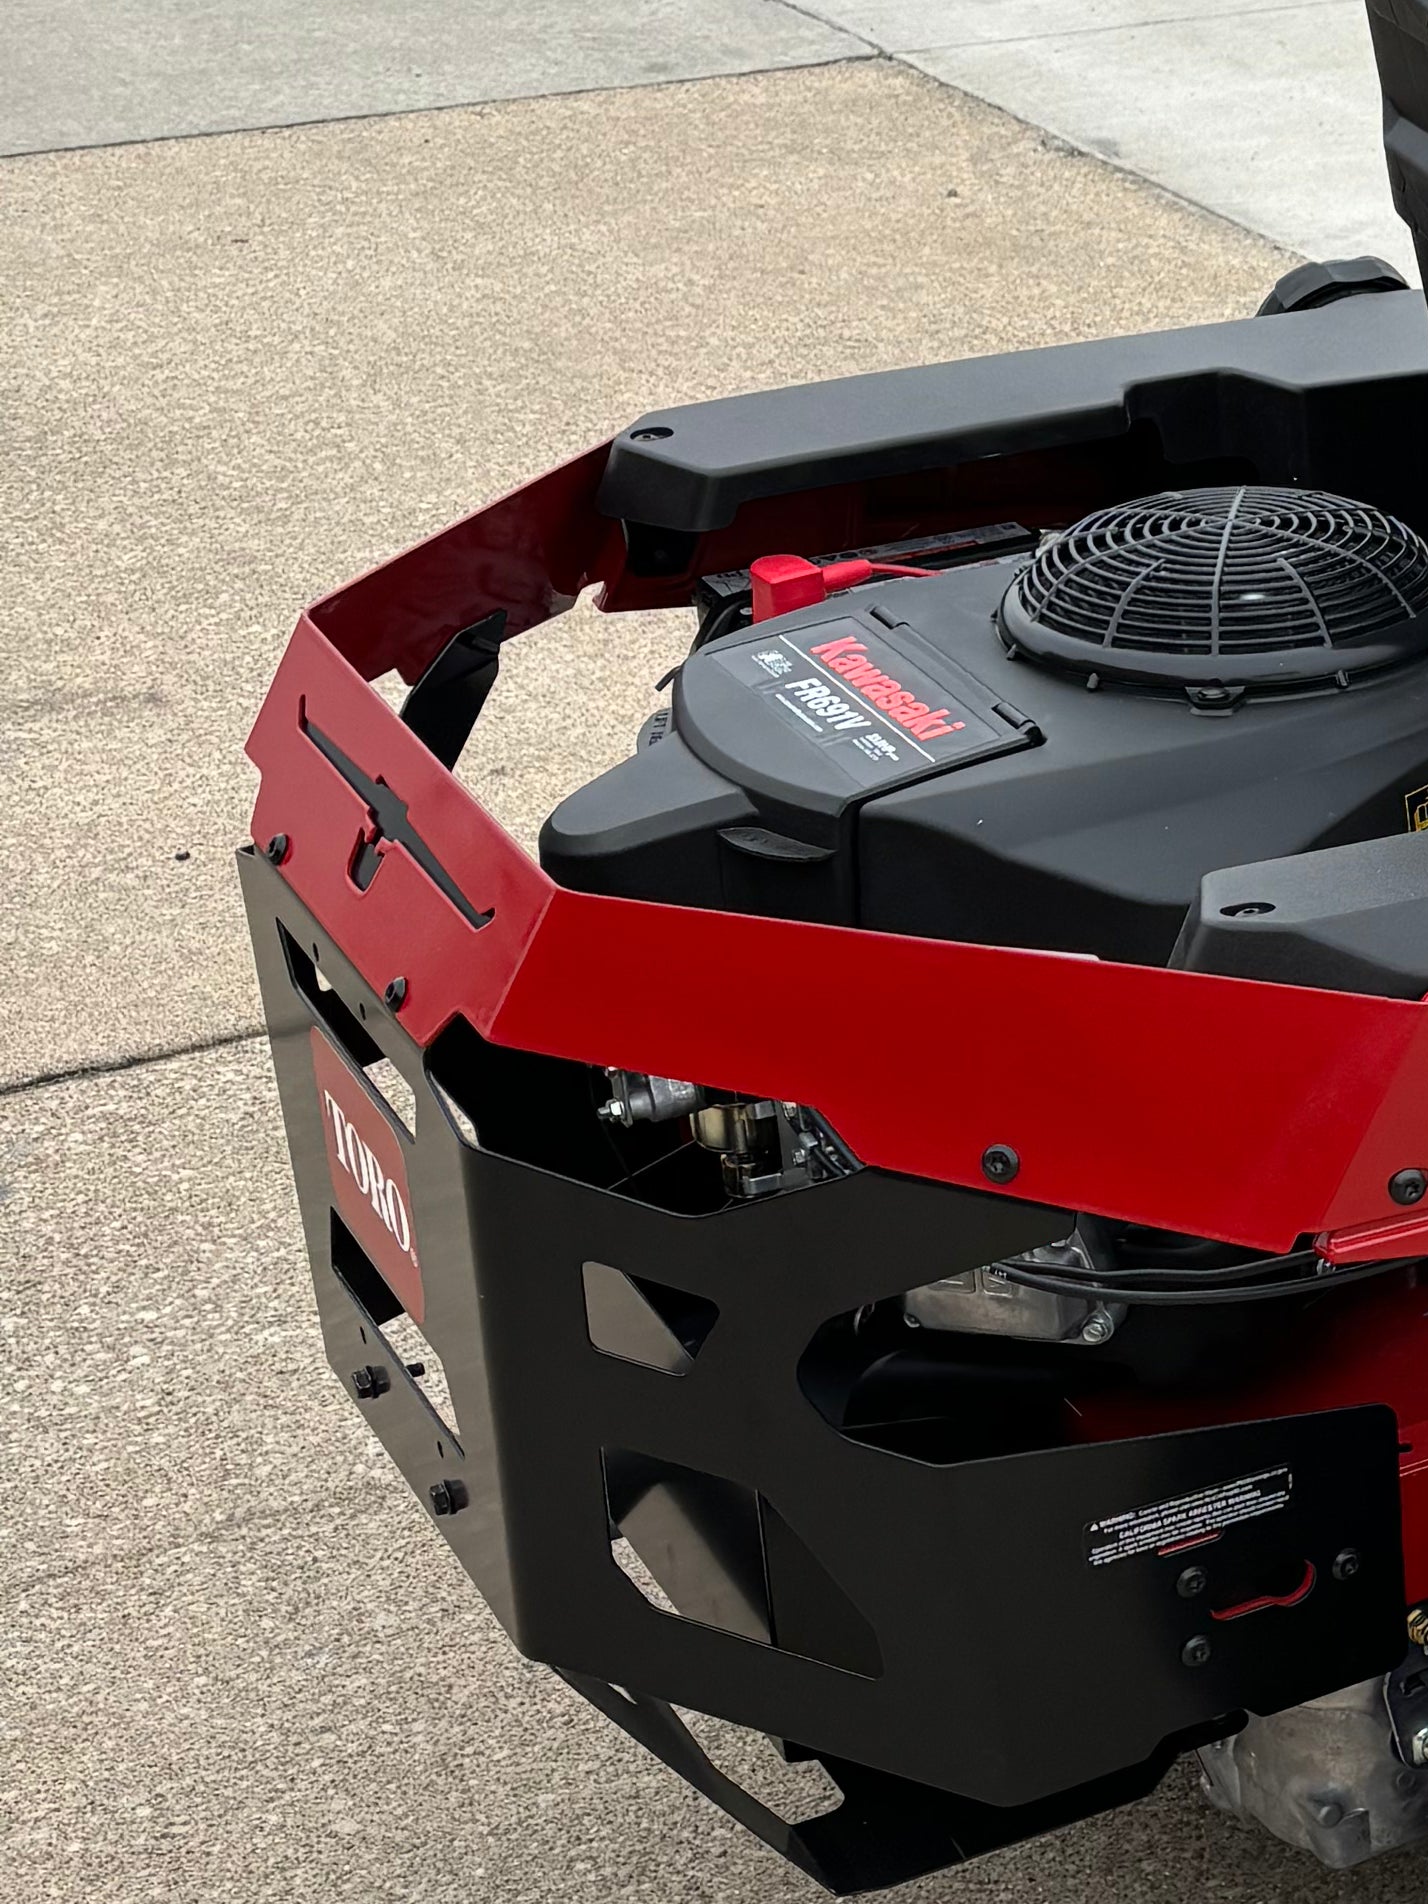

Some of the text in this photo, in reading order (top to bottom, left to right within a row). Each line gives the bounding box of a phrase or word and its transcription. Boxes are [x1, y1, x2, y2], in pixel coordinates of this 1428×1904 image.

[785, 677, 872, 730] FR691V
[810, 635, 966, 741] Kawasaki
[324, 1089, 410, 1252] TORO
